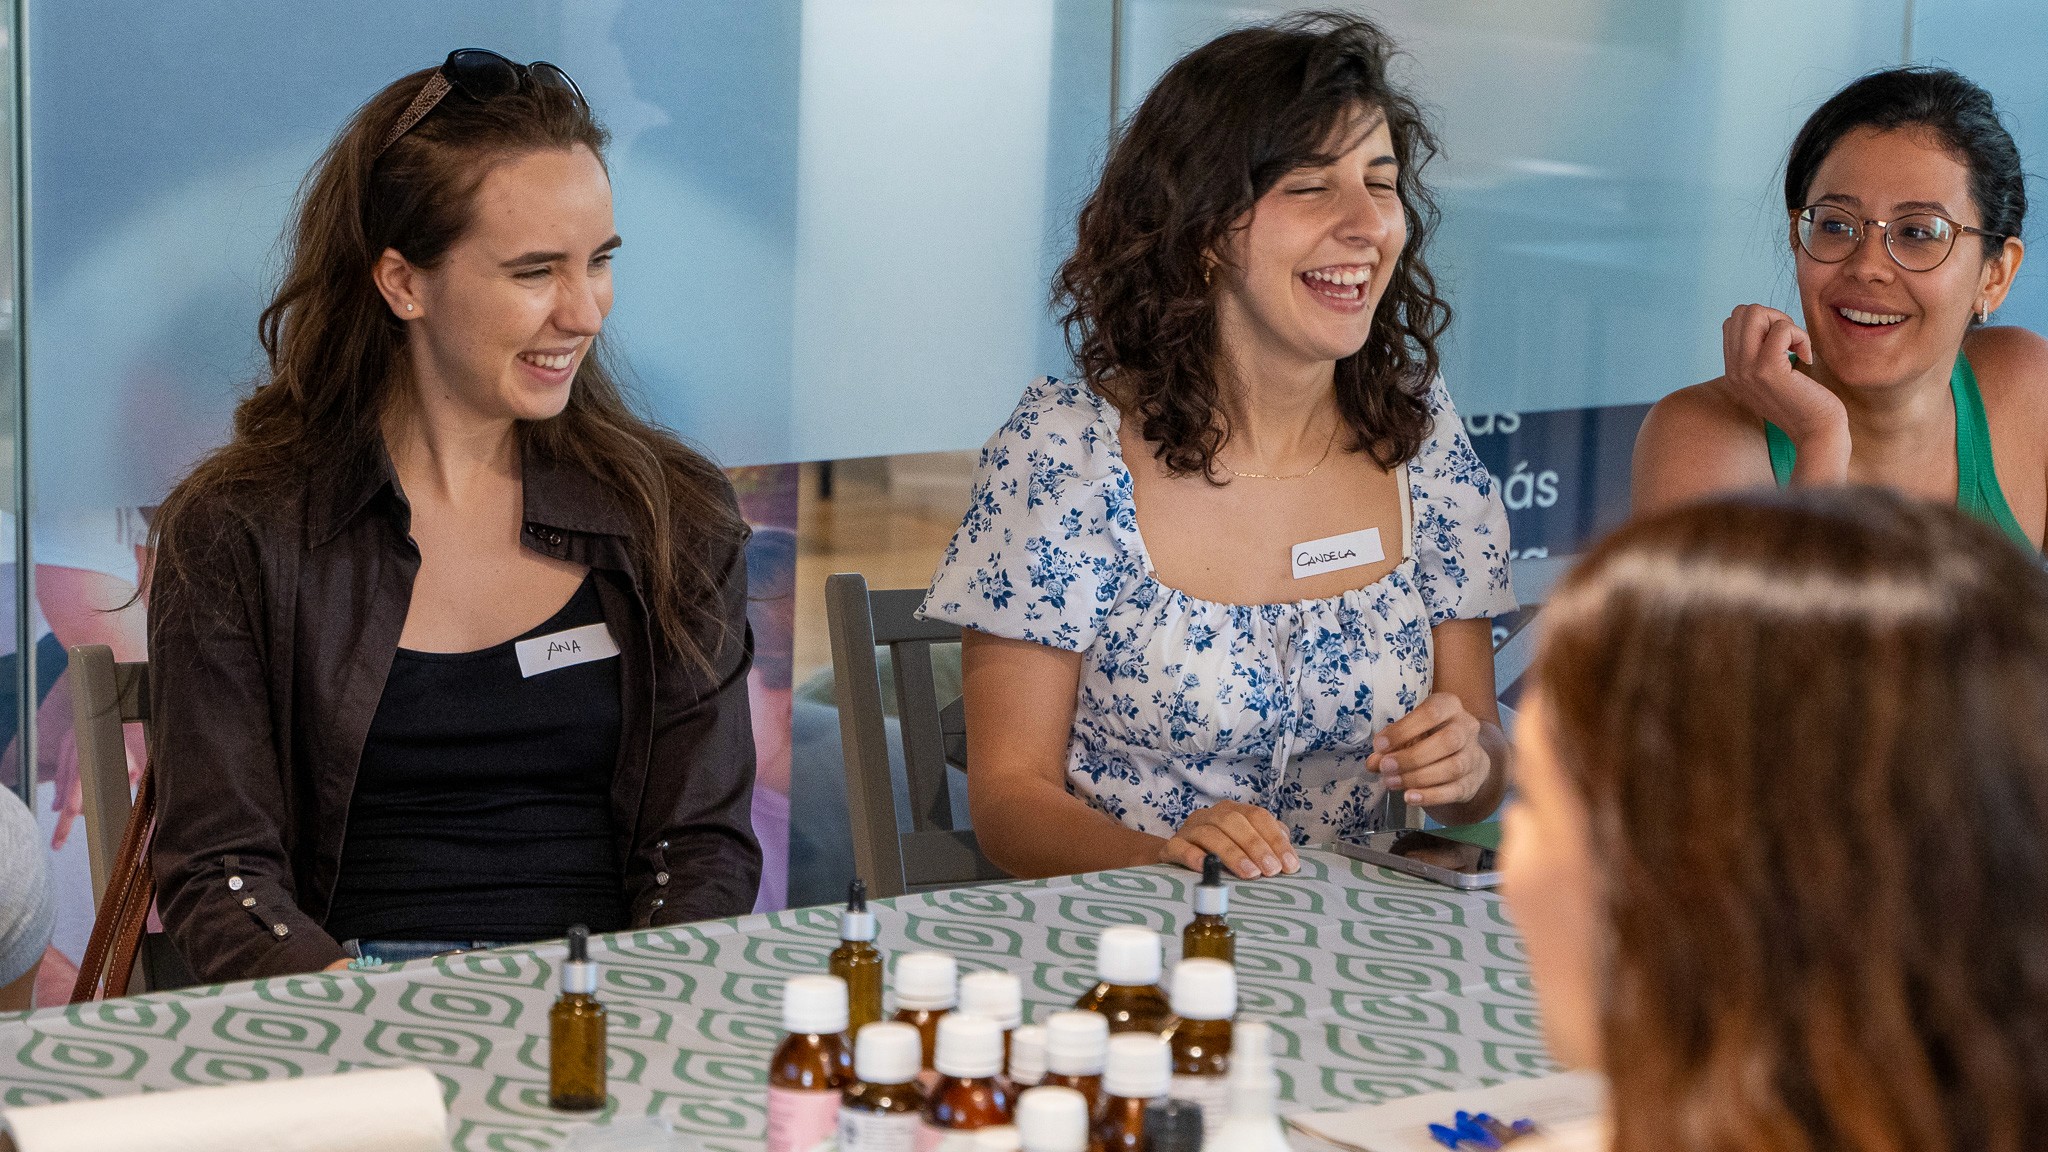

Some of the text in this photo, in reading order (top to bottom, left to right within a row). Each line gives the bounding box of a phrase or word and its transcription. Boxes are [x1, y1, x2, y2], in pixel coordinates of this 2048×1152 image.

[1490, 459, 1559, 510] ás
[1296, 549, 1357, 567] CANDELA
[546, 639, 582, 661] ANA
